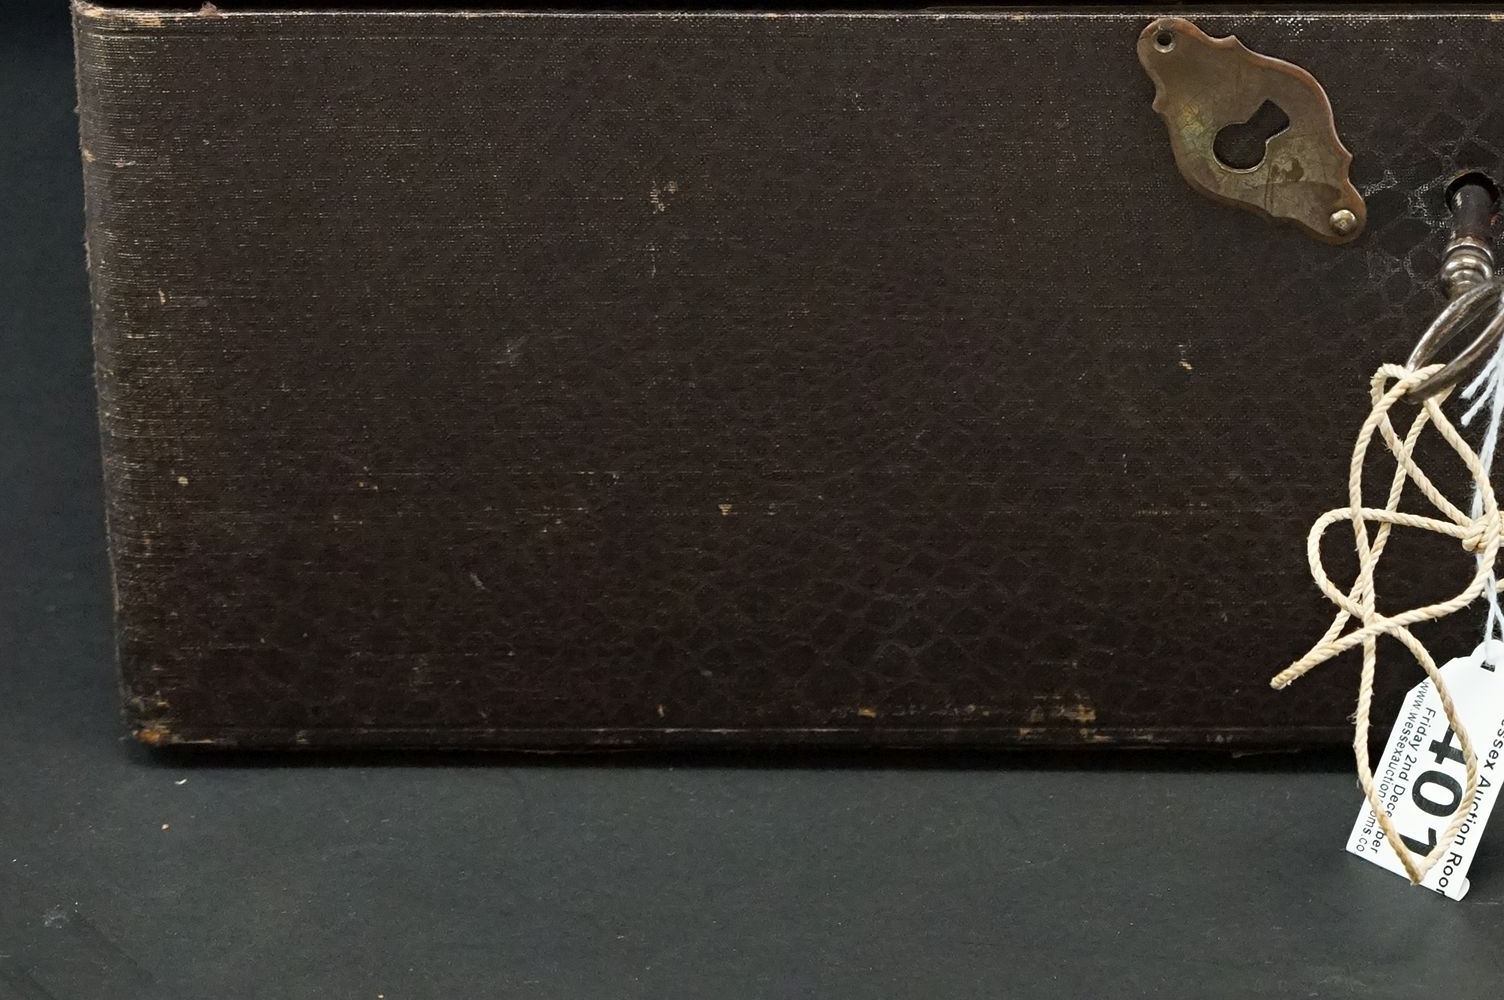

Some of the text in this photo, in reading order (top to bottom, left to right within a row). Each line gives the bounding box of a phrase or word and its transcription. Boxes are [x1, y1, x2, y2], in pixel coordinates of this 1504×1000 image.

[1370, 707, 1437, 854] Friday 2nd Deceber
[1397, 723, 1479, 857] 401
[1454, 775, 1491, 846] Auction
